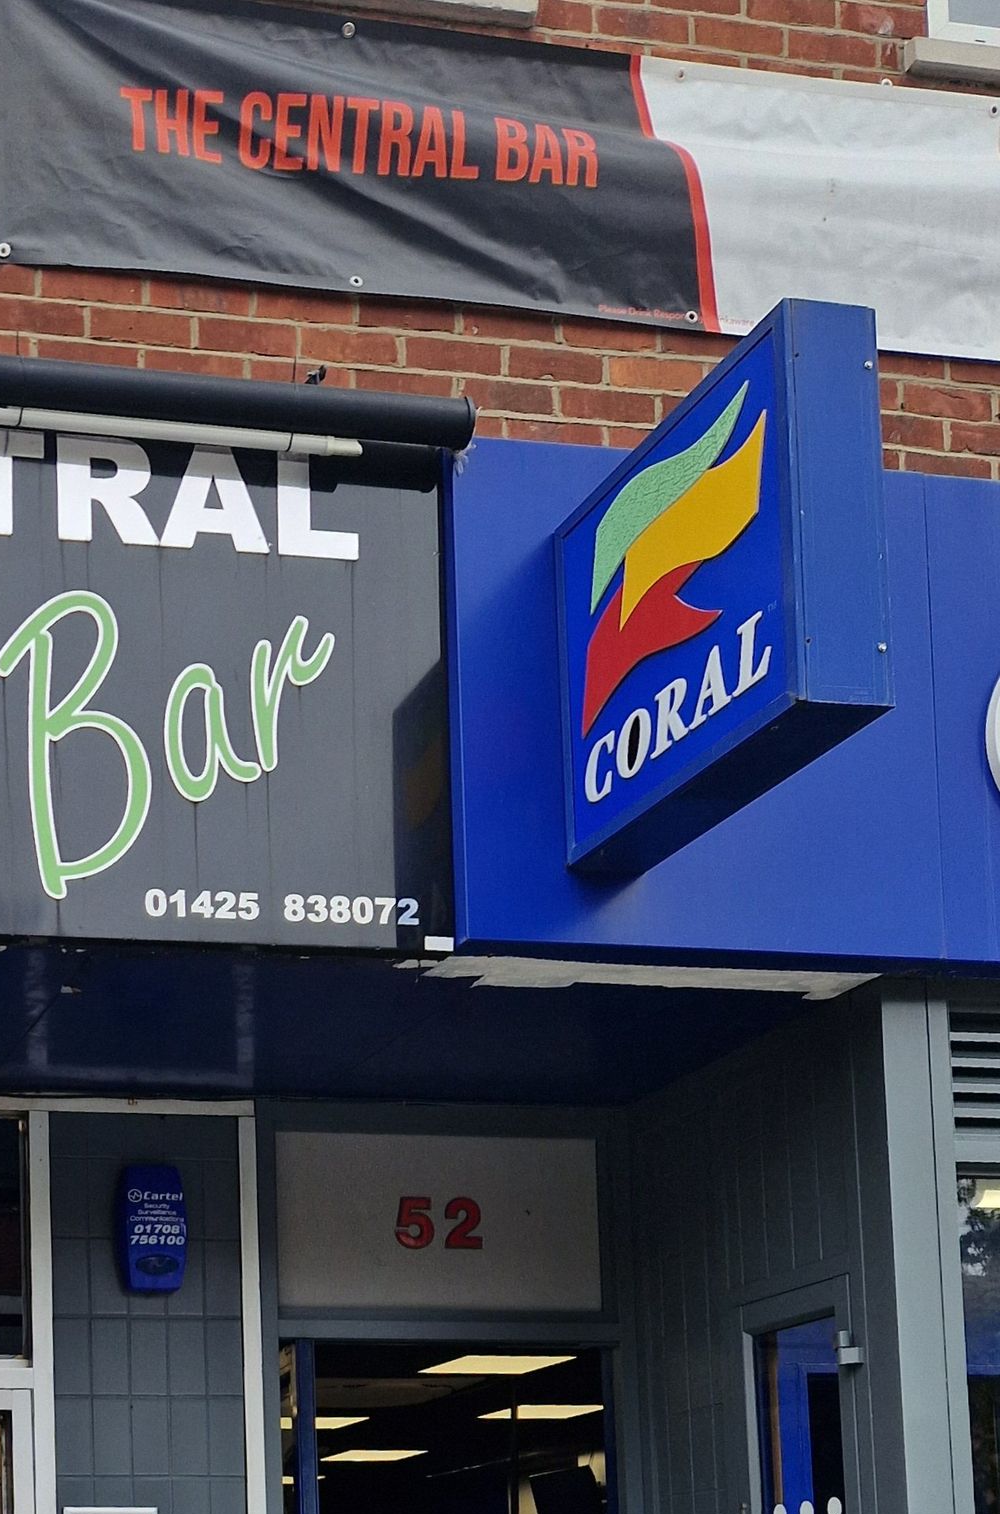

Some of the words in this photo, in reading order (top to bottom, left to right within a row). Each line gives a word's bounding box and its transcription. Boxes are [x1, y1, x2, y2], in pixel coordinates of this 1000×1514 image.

[119, 86, 224, 164] THE
[237, 91, 480, 181] CENTRAL
[493, 116, 599, 189] BAR
[585, 610, 773, 804] CORAL
[144, 888, 260, 921] 01425
[283, 893, 420, 926] 838072
[143, 1191, 183, 1201] Cartel
[130, 1235, 185, 1245] 756100
[134, 1224, 180, 1234] 01708
[394, 1196, 484, 1250] 52
